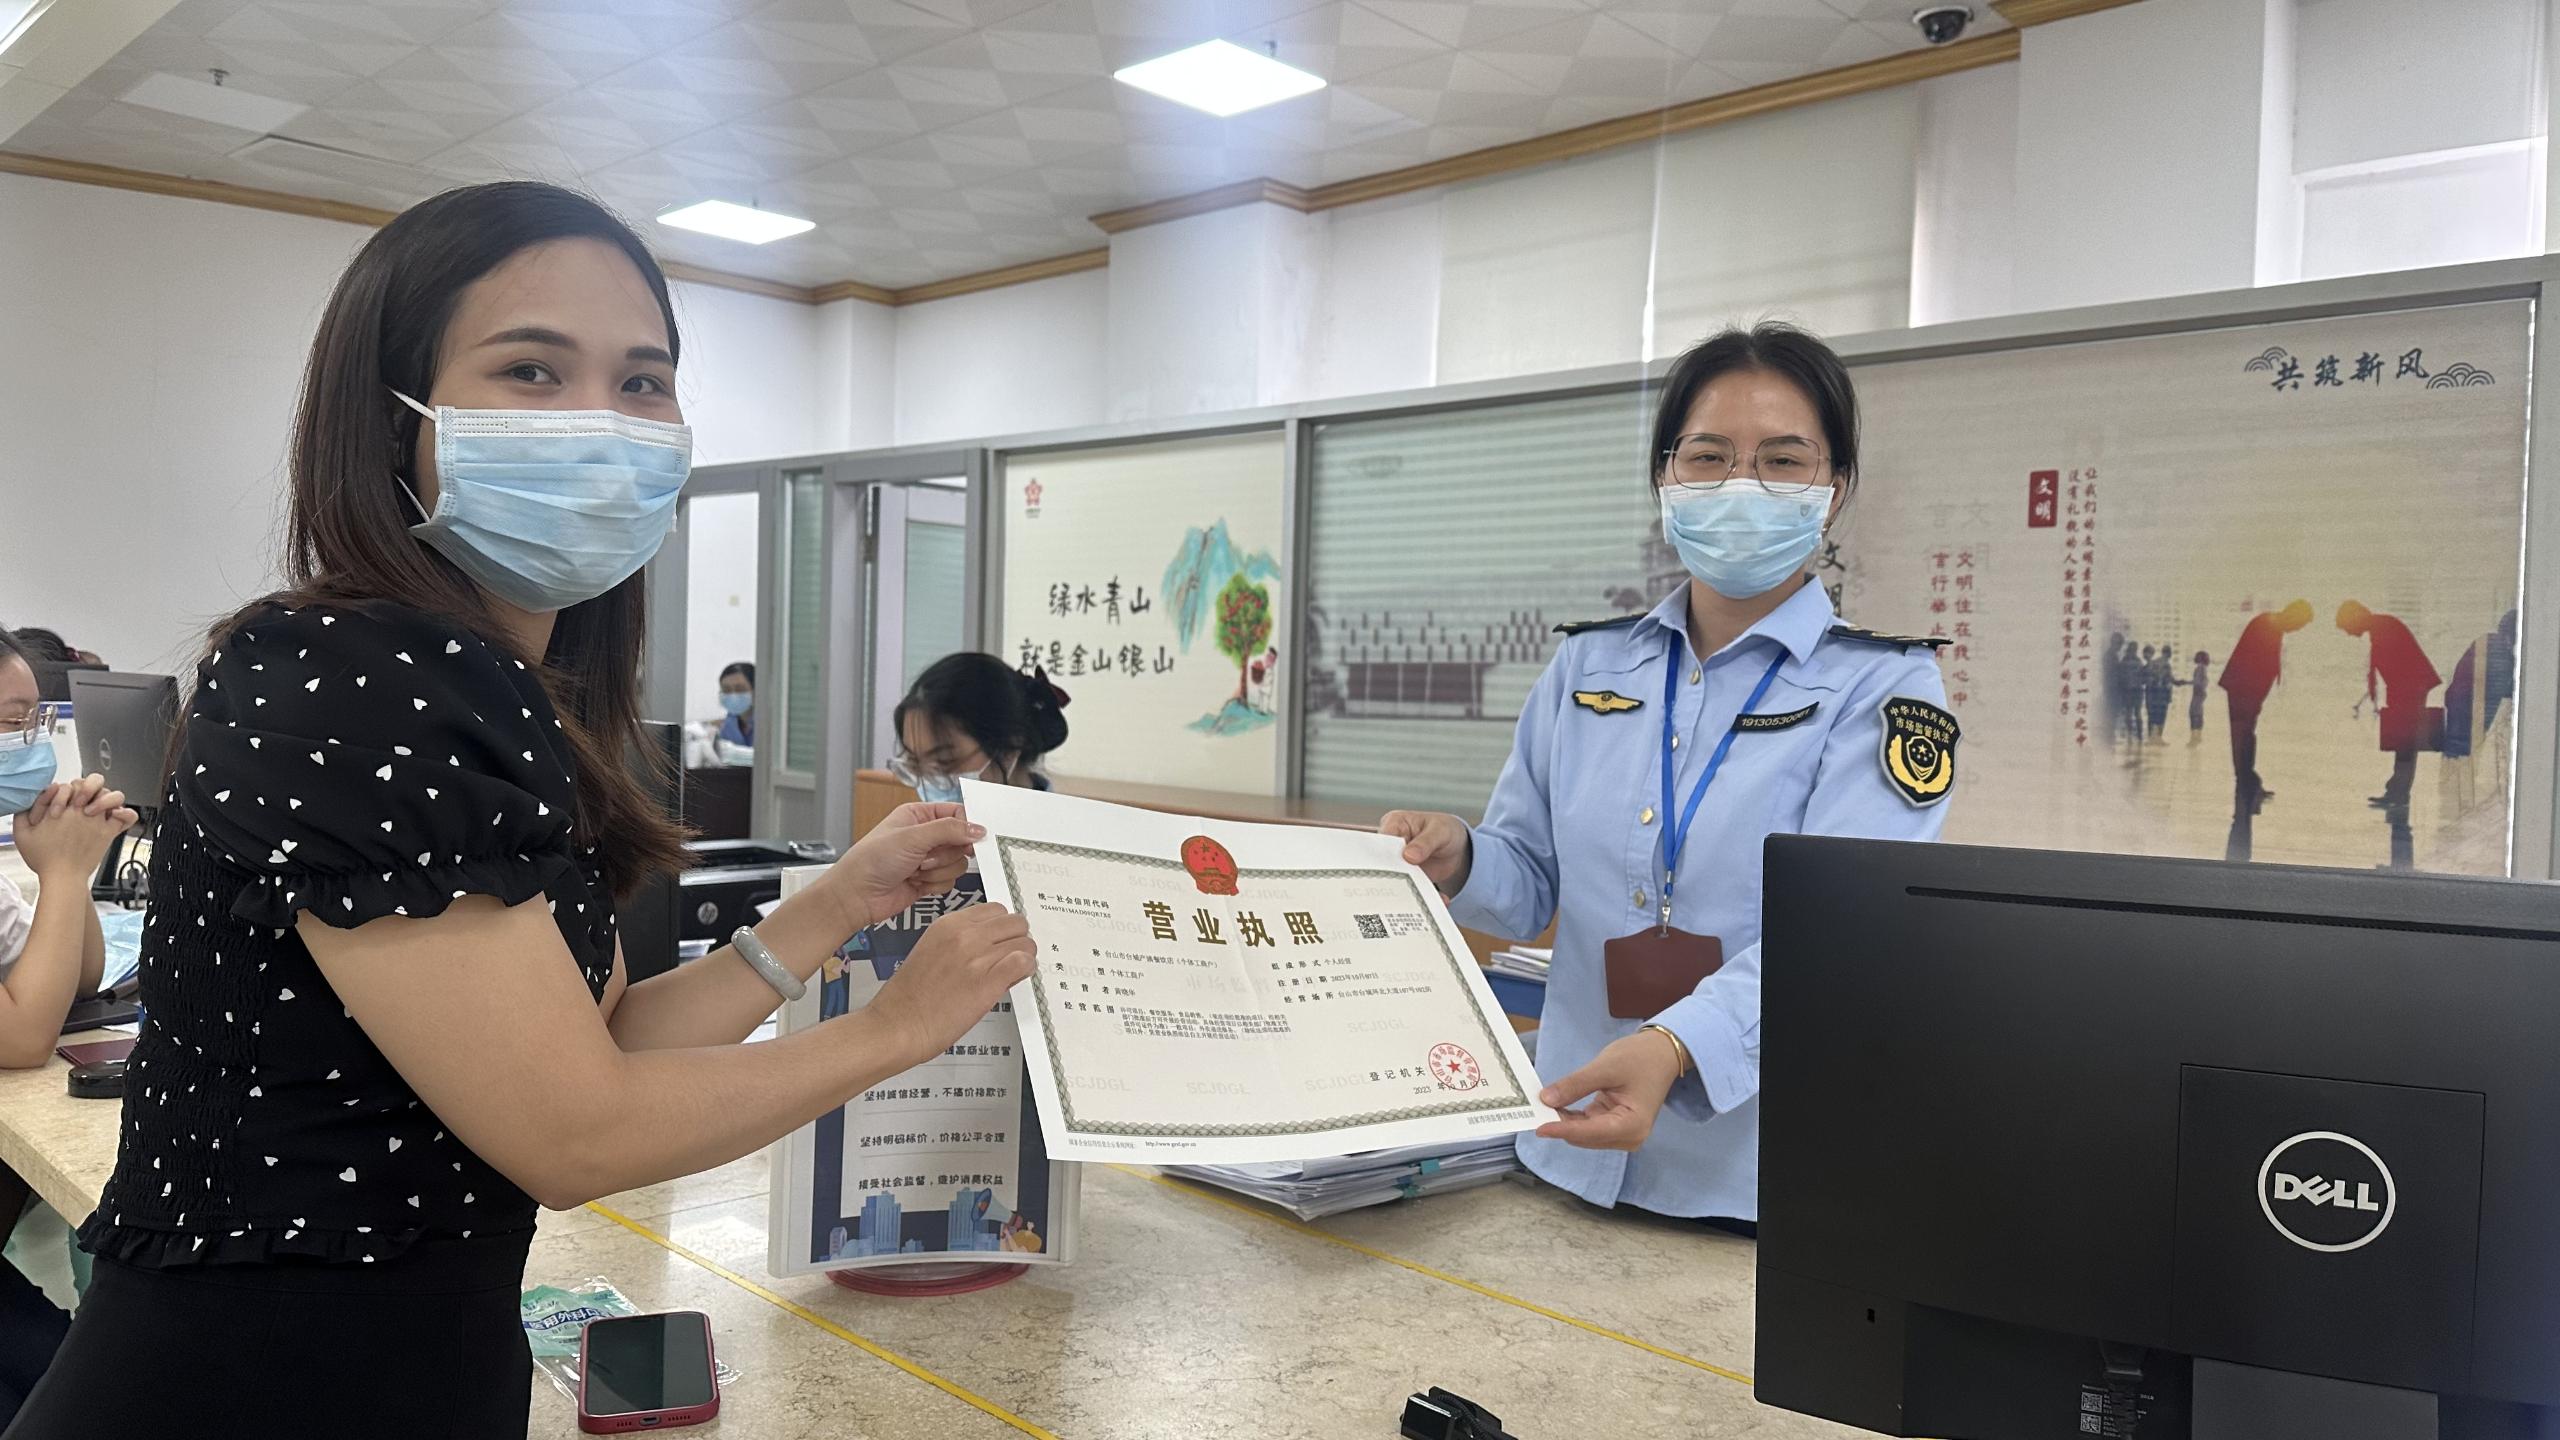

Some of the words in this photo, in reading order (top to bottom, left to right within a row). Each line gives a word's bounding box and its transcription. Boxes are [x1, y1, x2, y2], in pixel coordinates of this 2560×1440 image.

[2271, 348, 2430, 391] 共筑新风
[2035, 478, 2053, 521] 文明
[1049, 574, 1151, 625] 绿水青山
[1018, 638, 1175, 678] 就是金山银山
[1890, 705, 1955, 734] 中华人民共和国
[1038, 892, 1109, 909] 统一社会信用代码
[1142, 900, 1324, 947] 营业执照
[1271, 959, 1321, 971] 组成形式
[1059, 981, 1110, 995] 经营者
[1278, 975, 1328, 987] 注册日期
[1284, 991, 1334, 1004] 经营场所
[1064, 1001, 1115, 1014] 经营范围
[1369, 1066, 1426, 1082] 登记机关
[860, 1131, 1005, 1148] 坚持明码标价，价格公平合理
[858, 1174, 1004, 1191] 接受社会监督，维护消费权益
[2274, 1172, 2379, 1211] DELL
